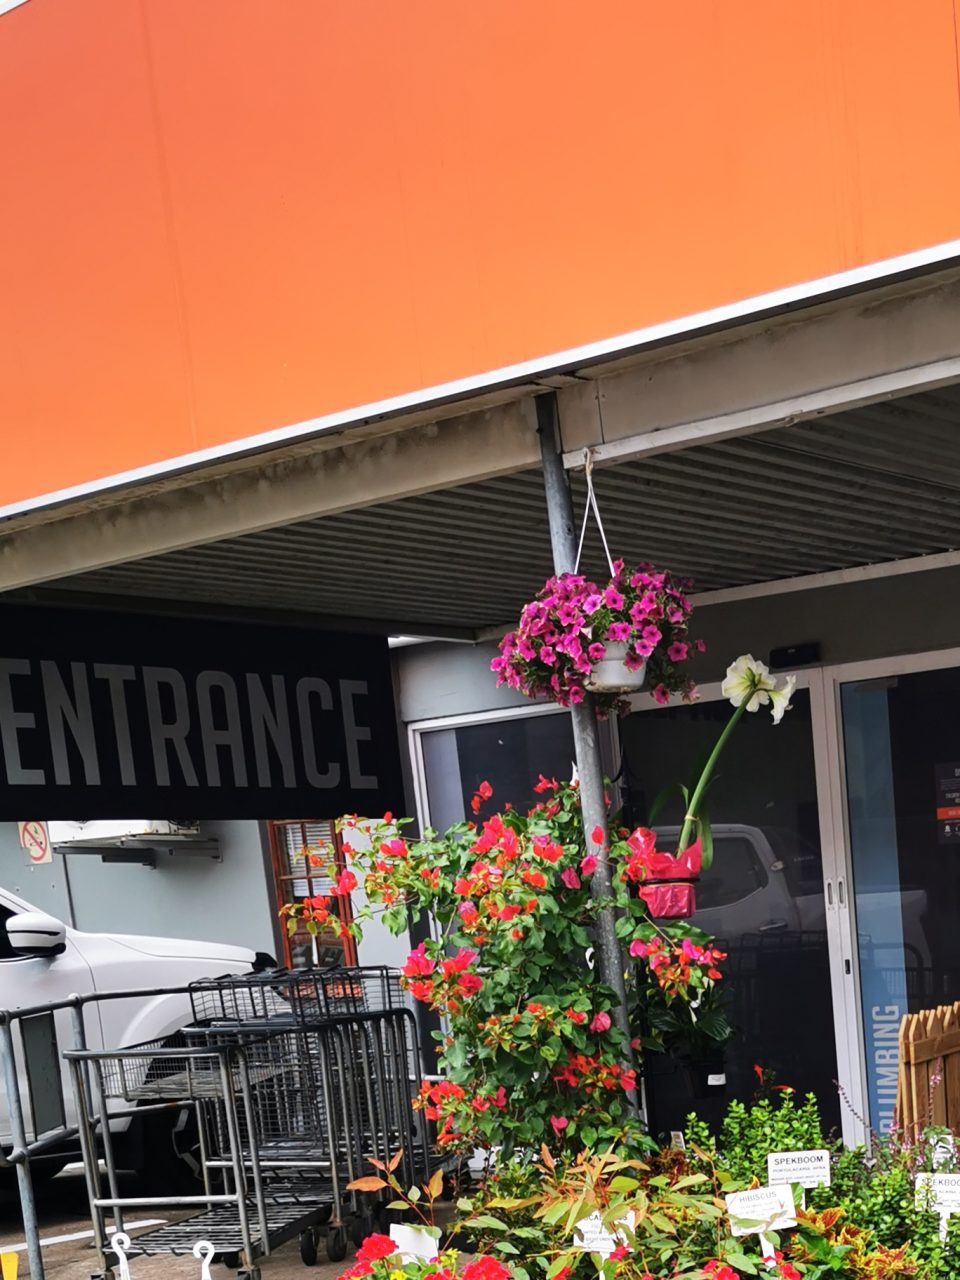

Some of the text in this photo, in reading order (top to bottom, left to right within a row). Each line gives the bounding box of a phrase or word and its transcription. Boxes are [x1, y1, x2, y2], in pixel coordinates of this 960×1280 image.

[0, 658, 379, 790] ENTRANCE
[774, 1155, 823, 1165] SPEKBOOM
[739, 1190, 777, 1203] HIBISCUS
